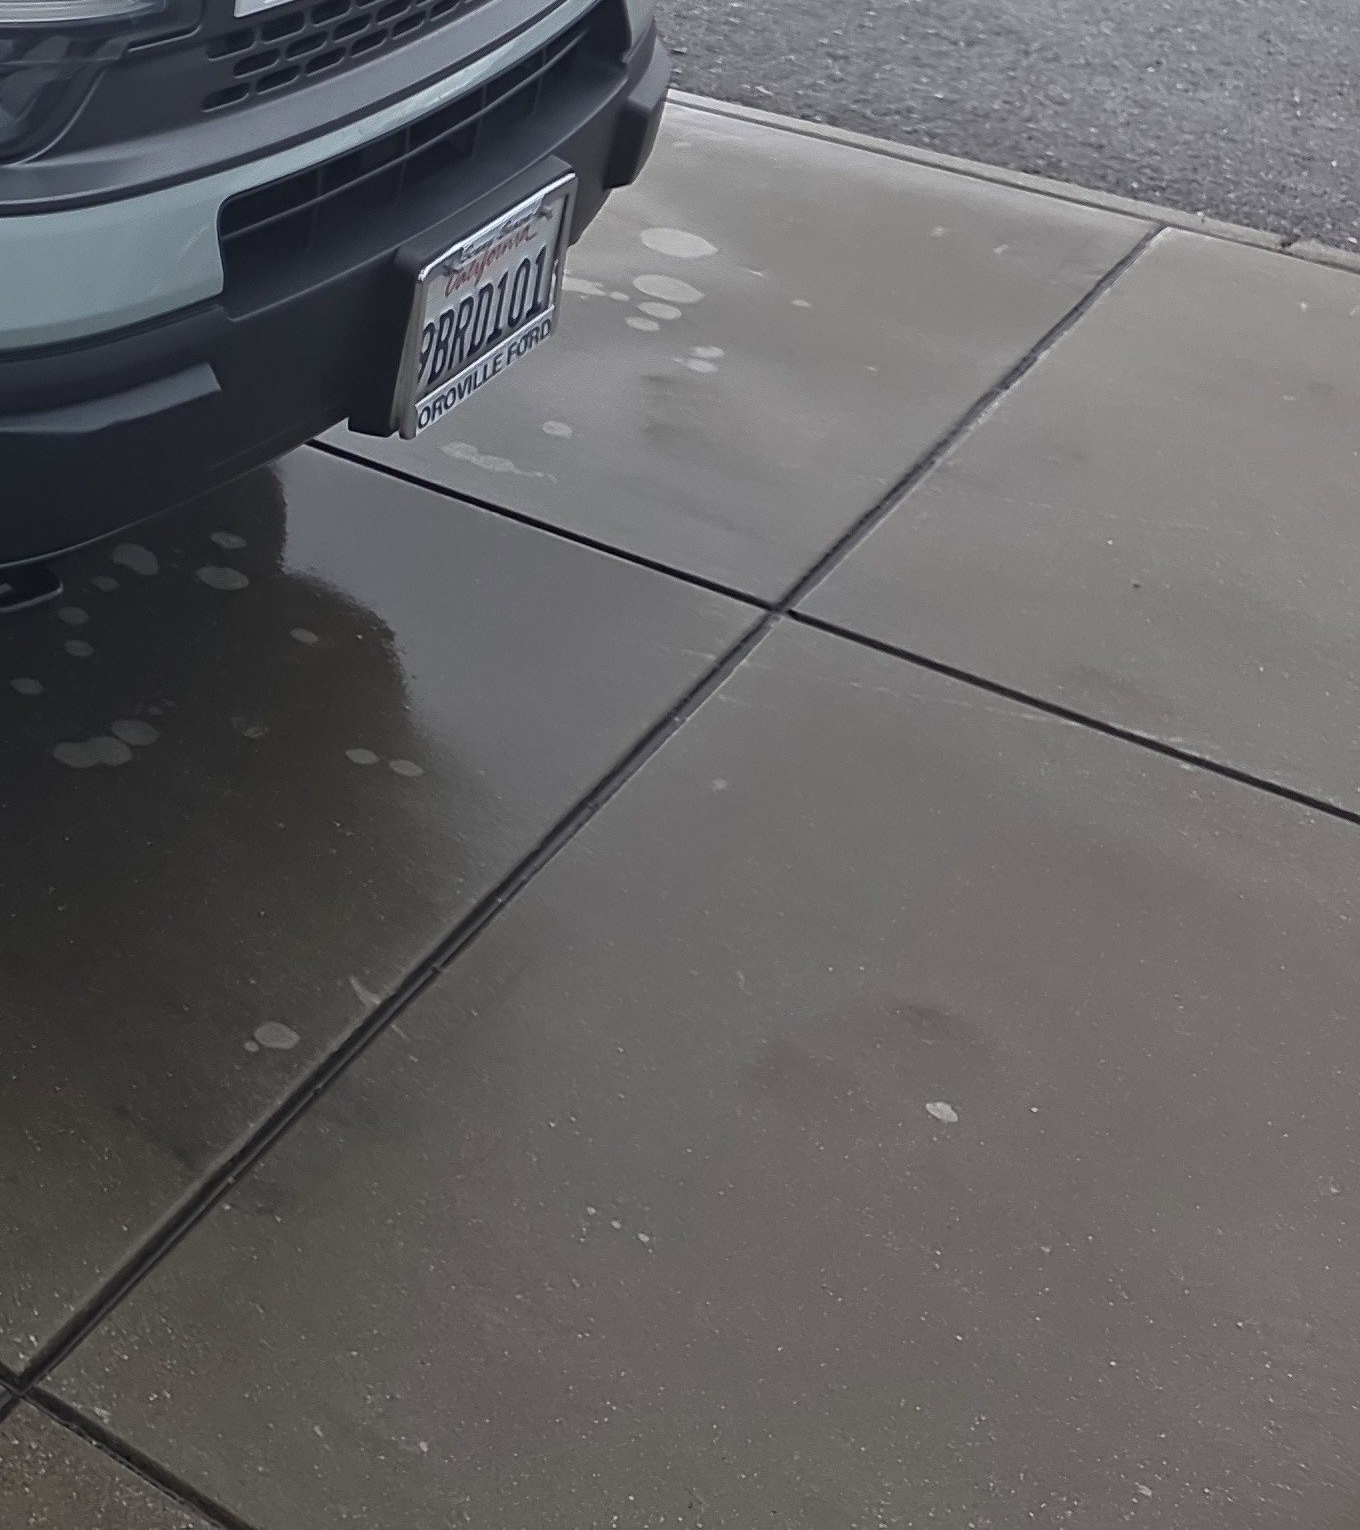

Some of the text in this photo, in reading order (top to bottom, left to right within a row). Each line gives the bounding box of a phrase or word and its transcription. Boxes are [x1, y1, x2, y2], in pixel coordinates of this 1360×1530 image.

[418, 246, 546, 384] 9BRD101
[419, 319, 552, 428] OROVILLE FORD
